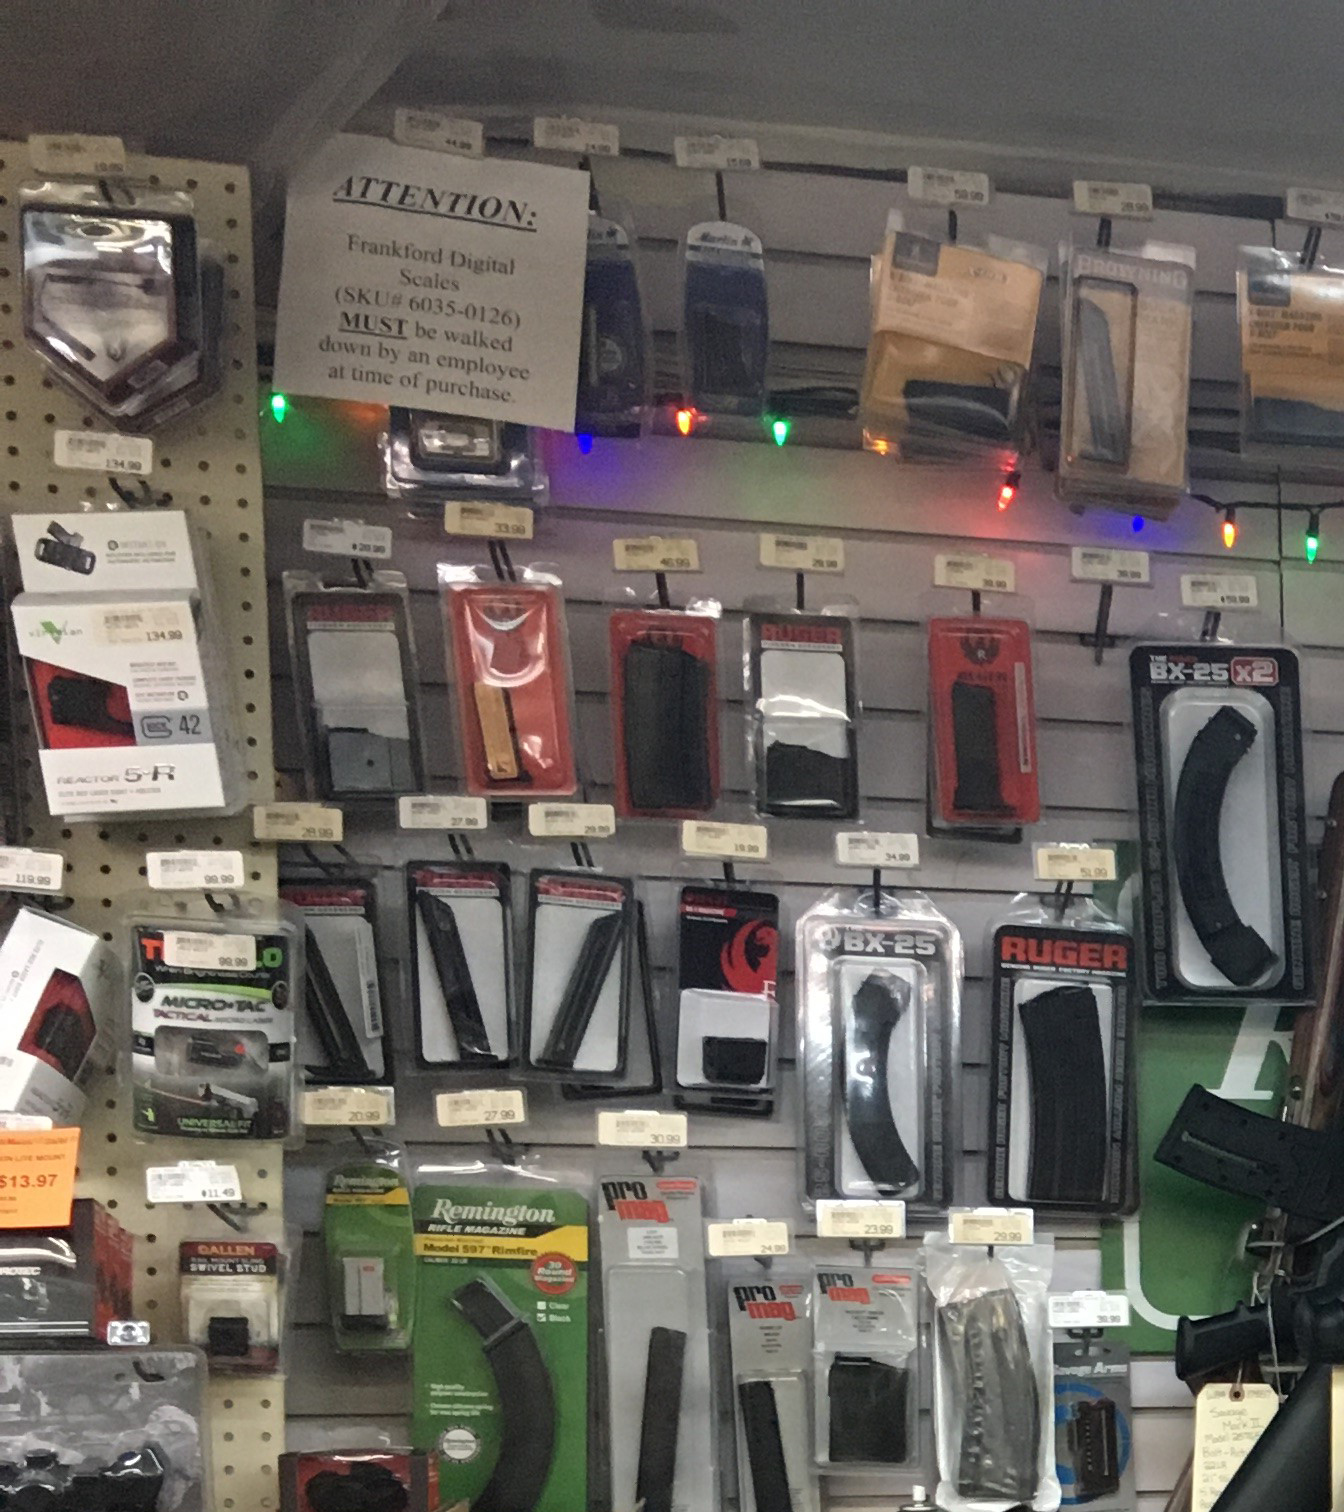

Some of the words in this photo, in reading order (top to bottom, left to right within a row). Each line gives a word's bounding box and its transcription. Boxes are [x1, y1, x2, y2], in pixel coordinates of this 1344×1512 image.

[332, 174, 537, 231] ATTENTION:
[346, 233, 443, 265] Frankford
[450, 250, 516, 277] Digital
[399, 268, 460, 293] Scales
[1077, 254, 1188, 289] BROWNING
[335, 286, 402, 310] (SKU#
[408, 295, 521, 330] 6035-0126)
[339, 311, 408, 340] MUST
[415, 320, 438, 341] be
[444, 327, 513, 353] walked
[319, 335, 371, 360] down
[377, 341, 400, 367] by
[407, 349, 431, 367] an
[436, 352, 530, 382] employee
[327, 363, 347, 381] at
[350, 364, 394, 386] time
[399, 371, 422, 389] of
[424, 376, 517, 404] purchase.
[761, 623, 841, 643] RUGER
[1150, 663, 1229, 680] BX-25
[179, 715, 202, 736] 42
[57, 774, 120, 786] REACTOR
[844, 932, 936, 955] BX-25
[1001, 937, 1128, 969] RUGER
[0, 1174, 57, 1189] $13.97
[334, 1174, 399, 1189] Remington
[602, 1181, 647, 1211] pro
[431, 1198, 555, 1225] Remington
[428, 1223, 463, 1235] RIFLE
[466, 1224, 526, 1236] MAGAZINE
[423, 1243, 459, 1254] Model
[491, 1245, 538, 1258] Rimfire
[190, 1263, 234, 1273] SWIVEL
[237, 1263, 267, 1274] STUD
[733, 1286, 776, 1312] pro
